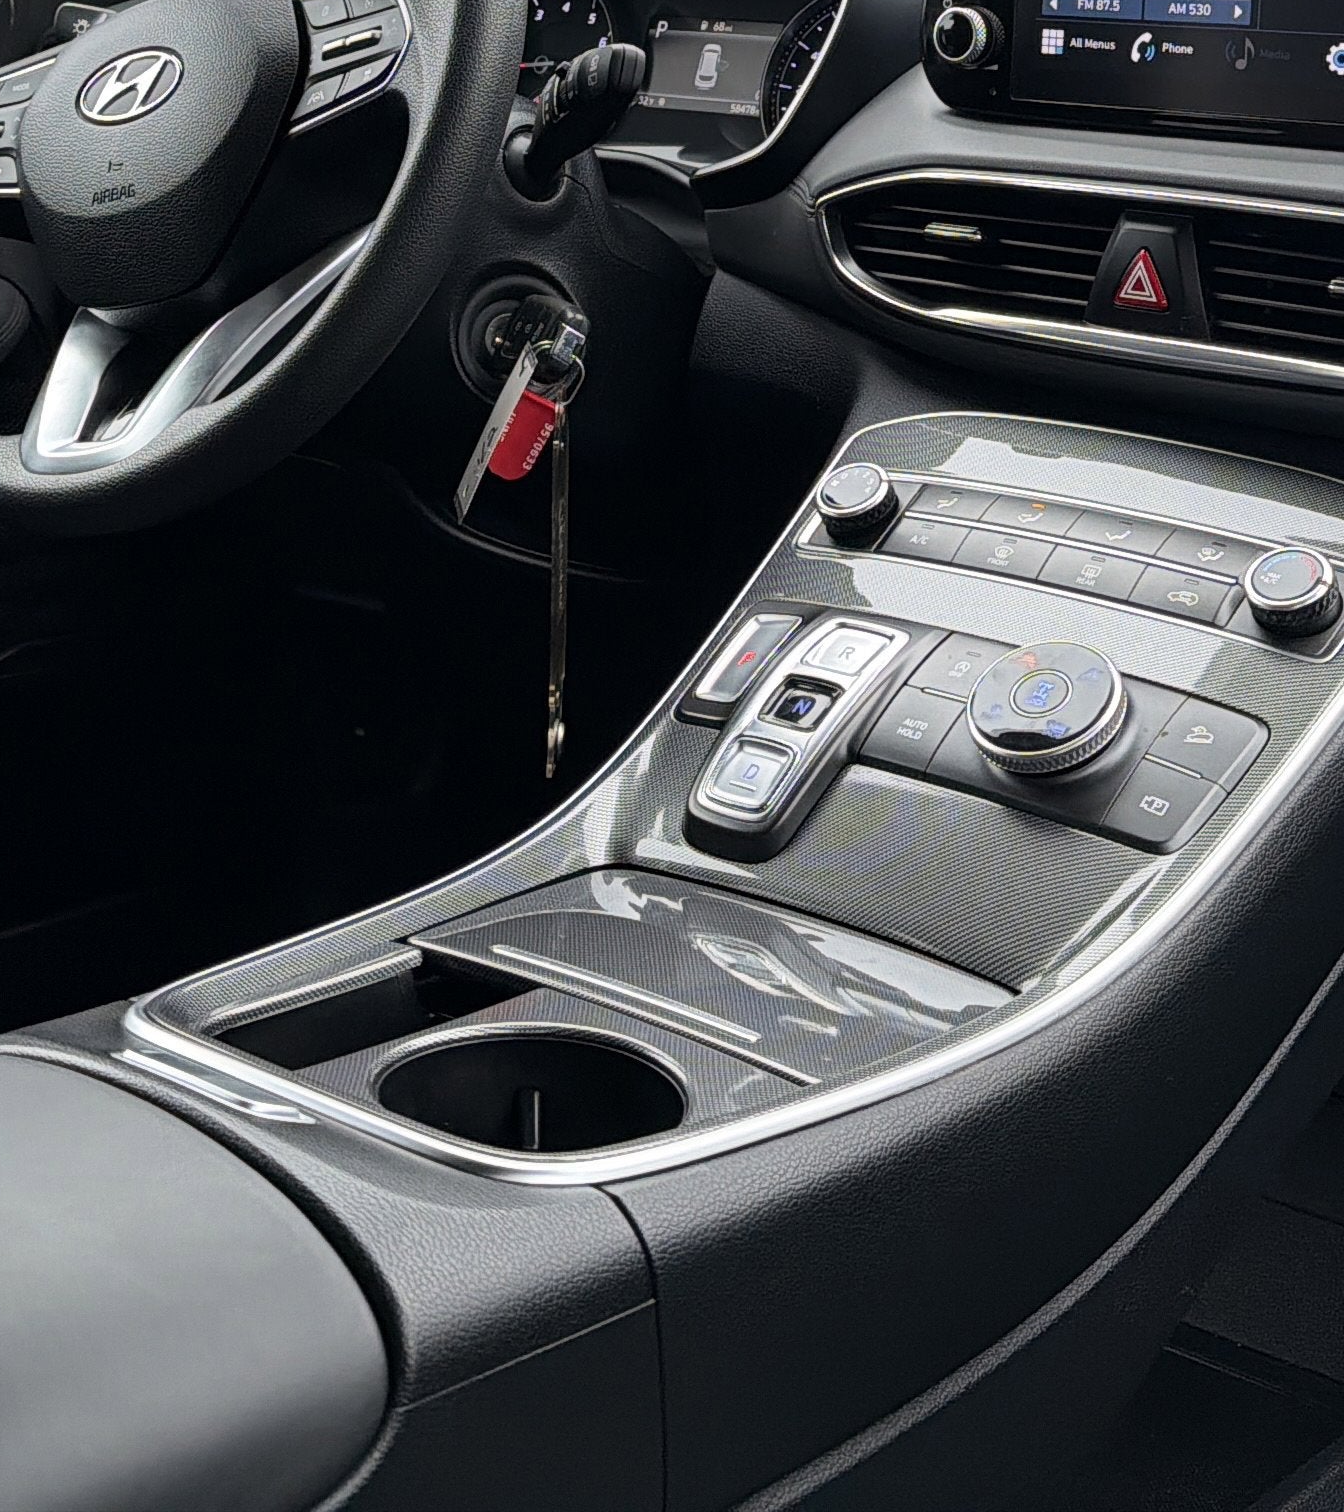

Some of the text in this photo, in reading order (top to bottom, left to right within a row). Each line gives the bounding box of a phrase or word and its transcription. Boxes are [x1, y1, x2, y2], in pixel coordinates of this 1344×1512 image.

[561, 1, 571, 13] 4
[1095, 0, 1120, 12] 87.5
[1168, 3, 1212, 16] AM 530
[534, 9, 545, 22] 3
[587, 12, 597, 25] 5
[655, 20, 669, 39] P
[1069, 37, 1117, 51] All Menus
[1162, 42, 1194, 55] Phone
[91, 183, 136, 207] AIRBAG
[909, 534, 929, 545] A/C
[1075, 576, 1096, 587] REAR
[839, 645, 856, 660] R
[792, 698, 811, 716] N
[903, 717, 929, 731] AUTO
[896, 726, 923, 741] HOLD
[742, 762, 761, 780] D
